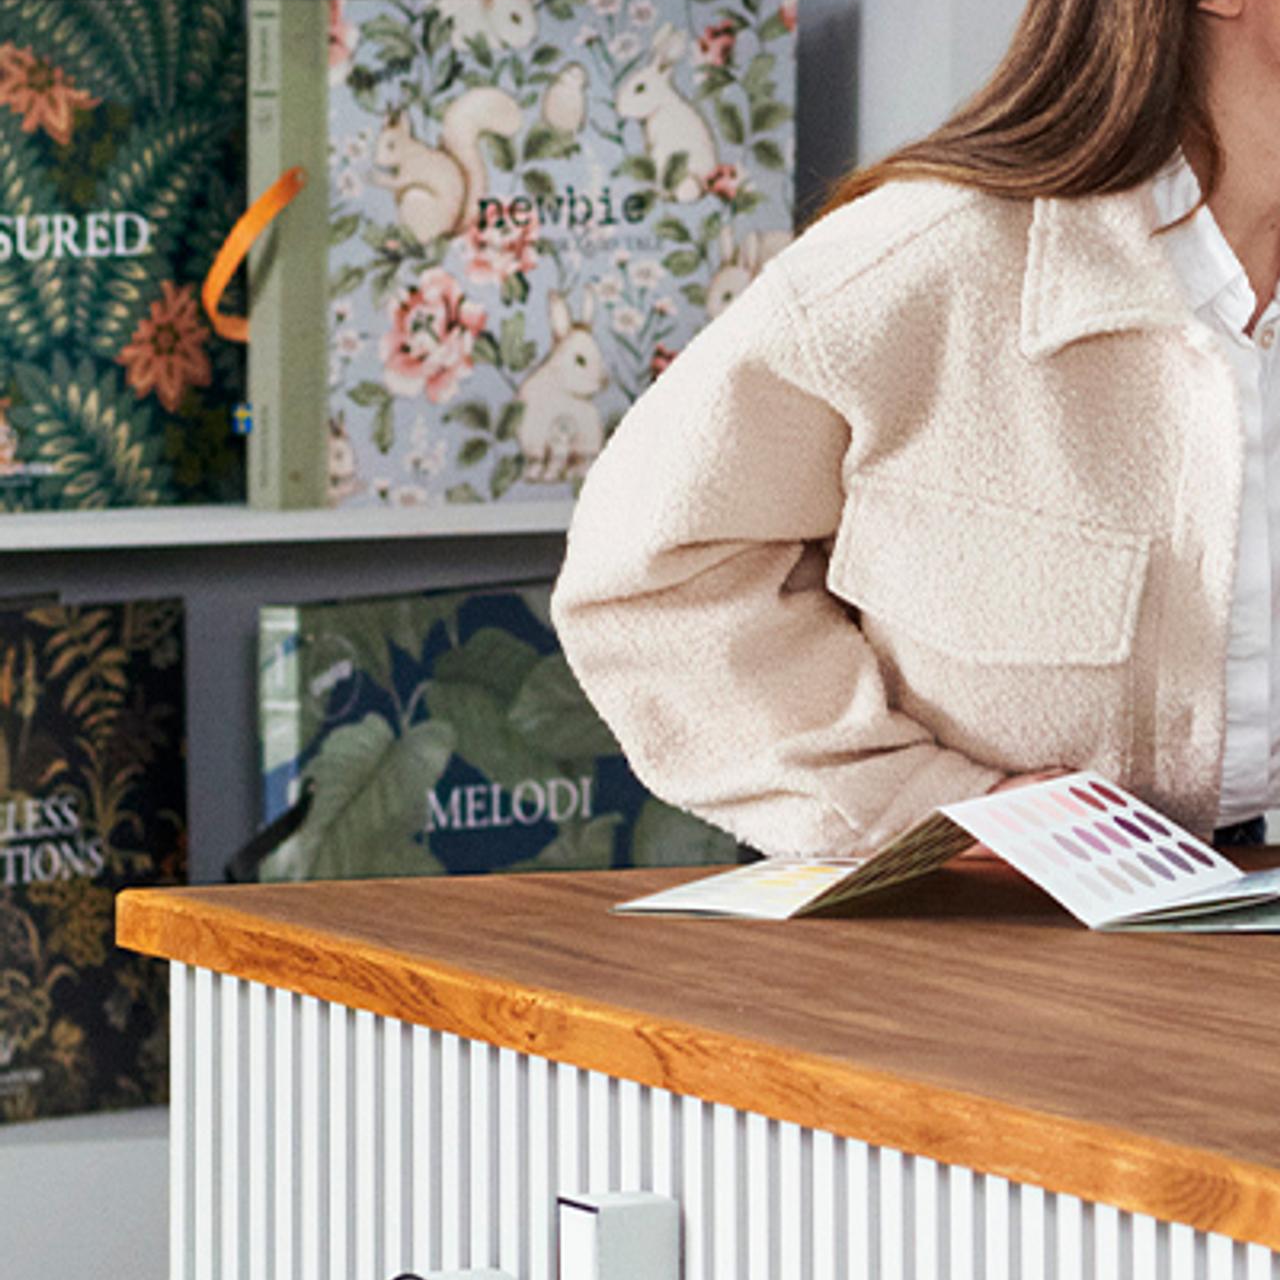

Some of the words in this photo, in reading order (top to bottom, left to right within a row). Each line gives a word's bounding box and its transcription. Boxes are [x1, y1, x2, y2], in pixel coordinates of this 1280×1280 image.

[478, 185, 648, 231] newbie
[0, 795, 80, 839] LESS
[425, 776, 592, 832] MELODI
